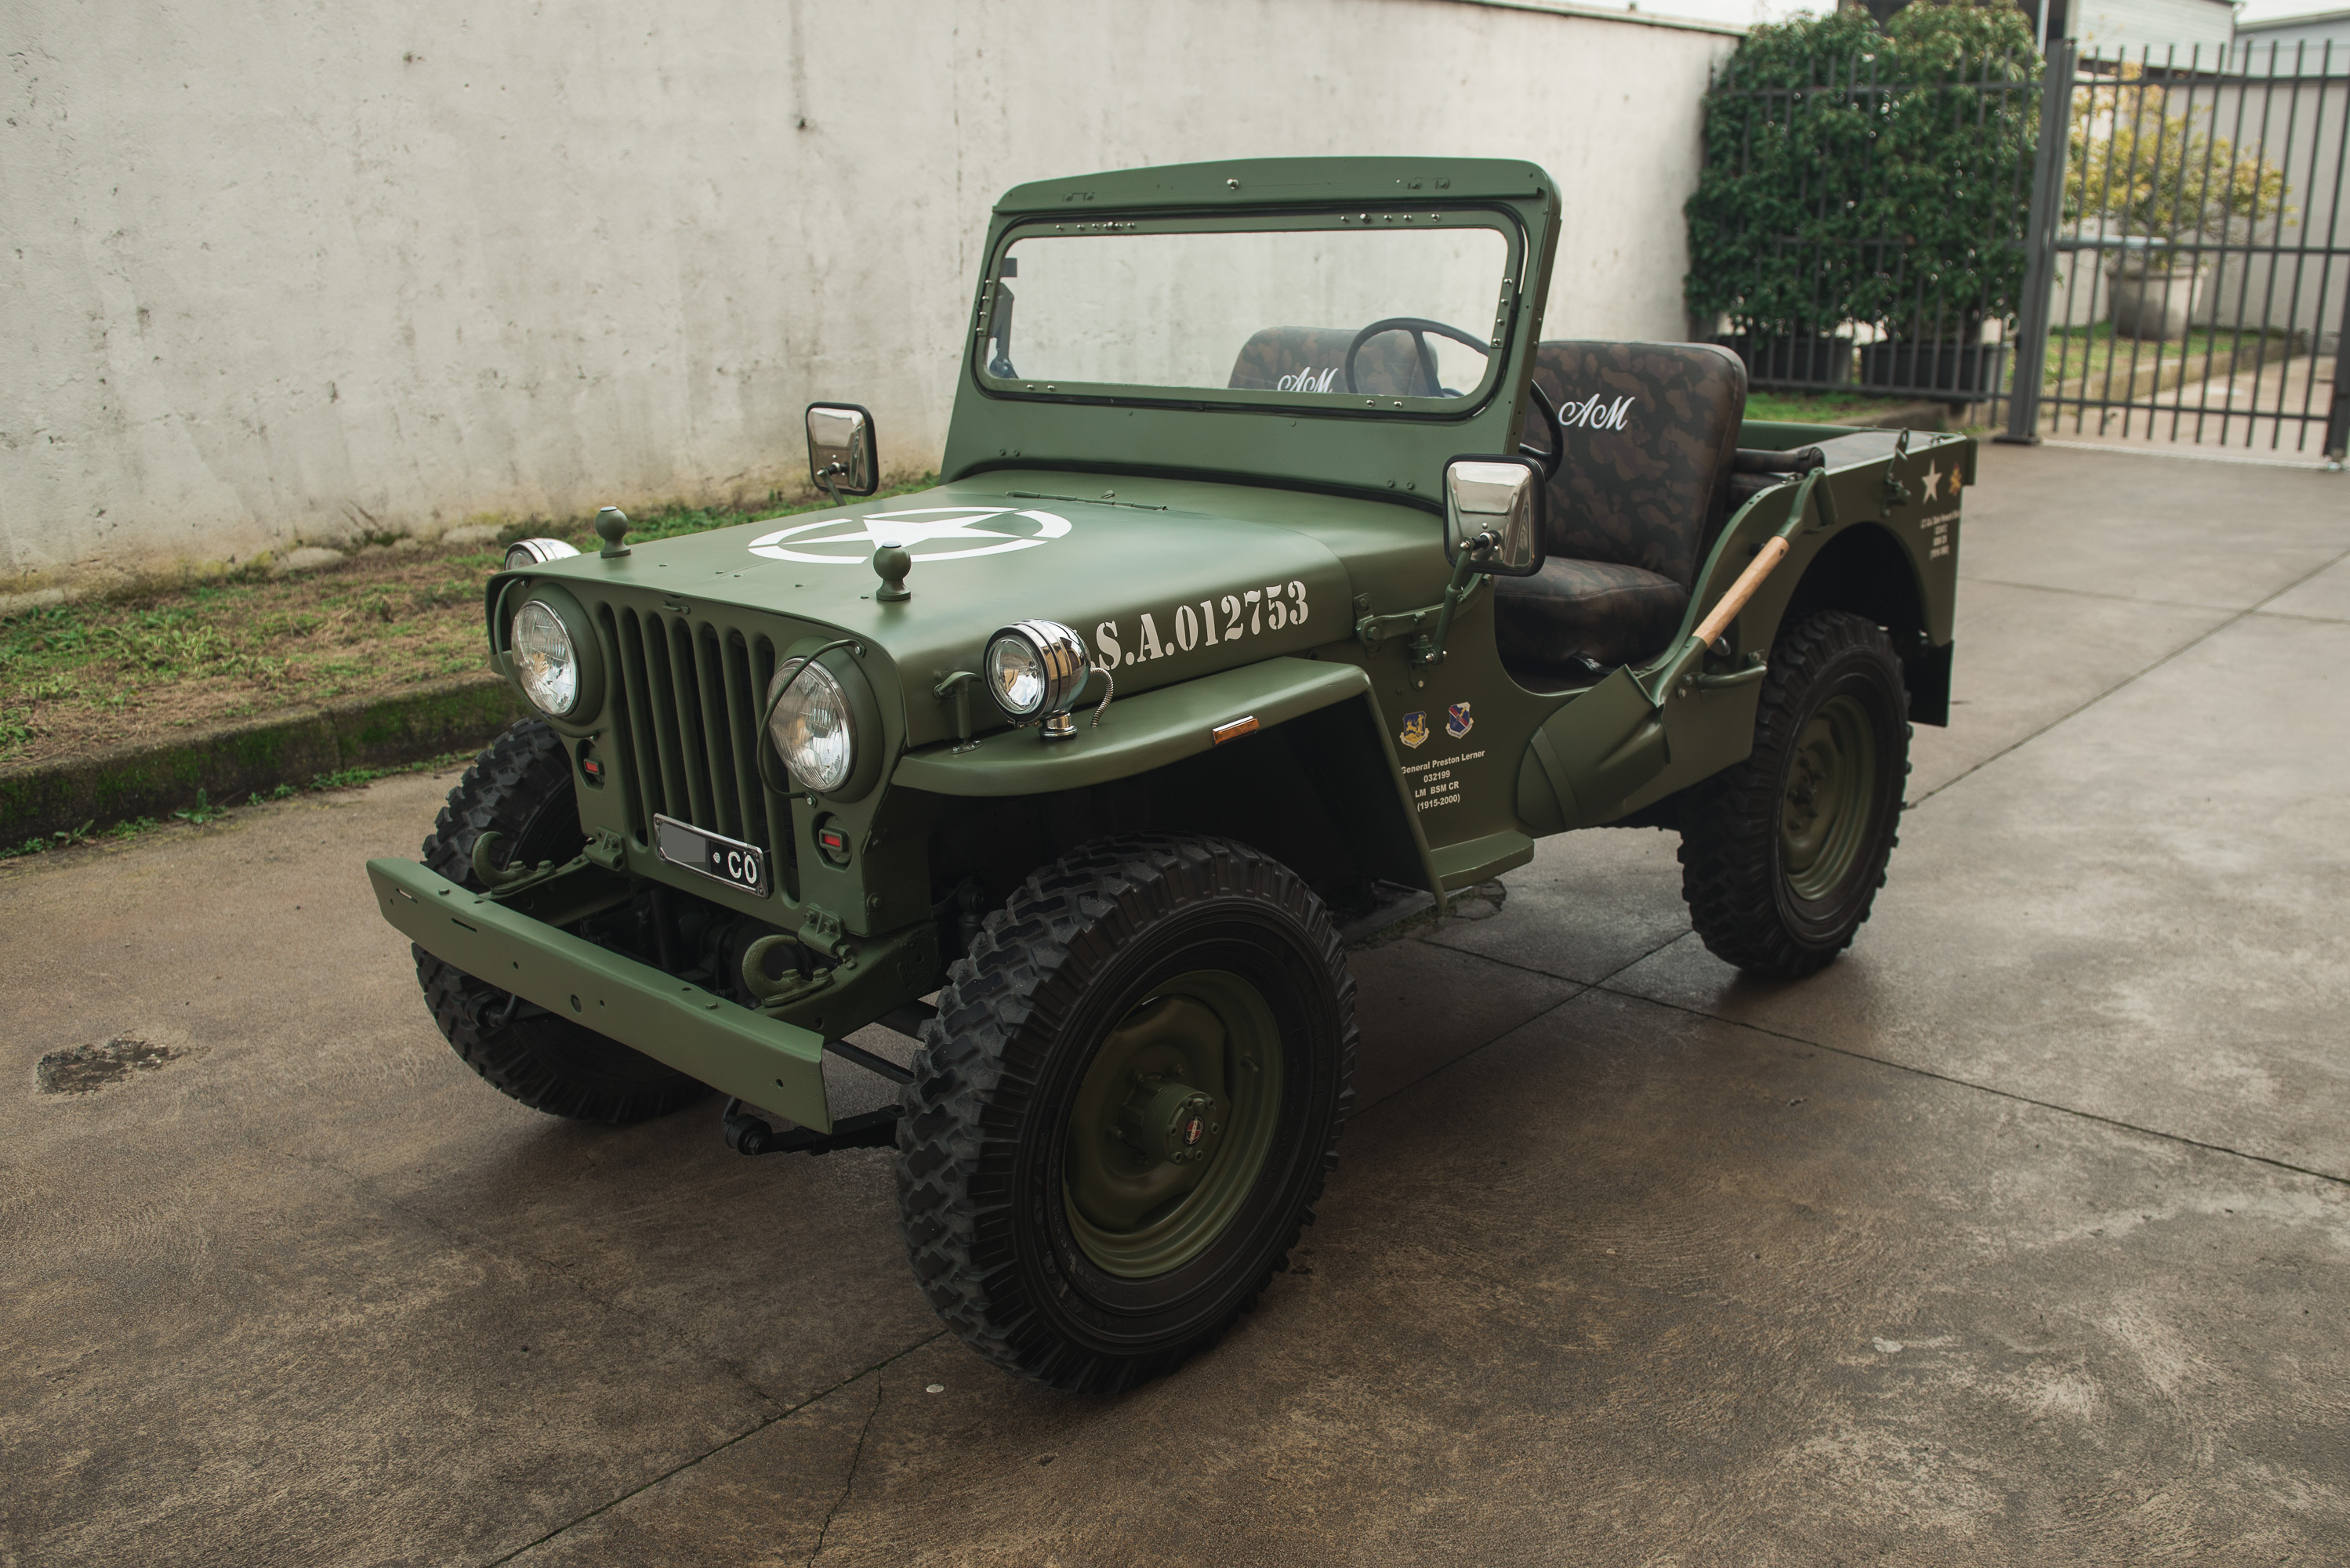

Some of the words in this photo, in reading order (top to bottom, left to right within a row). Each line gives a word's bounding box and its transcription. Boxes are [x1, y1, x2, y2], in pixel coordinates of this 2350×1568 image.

[1558, 393, 1636, 431] AM
[1090, 581, 1309, 671] S.A.012753
[1401, 762, 1431, 773] General
[1432, 757, 1460, 768] Preston
[1461, 751, 1485, 761] Lerner
[1423, 770, 1450, 782] 032199
[1415, 788, 1426, 798] LM
[1431, 784, 1446, 794] BSM
[1417, 794, 1460, 812] (1915-2000)
[727, 851, 757, 885] CO
